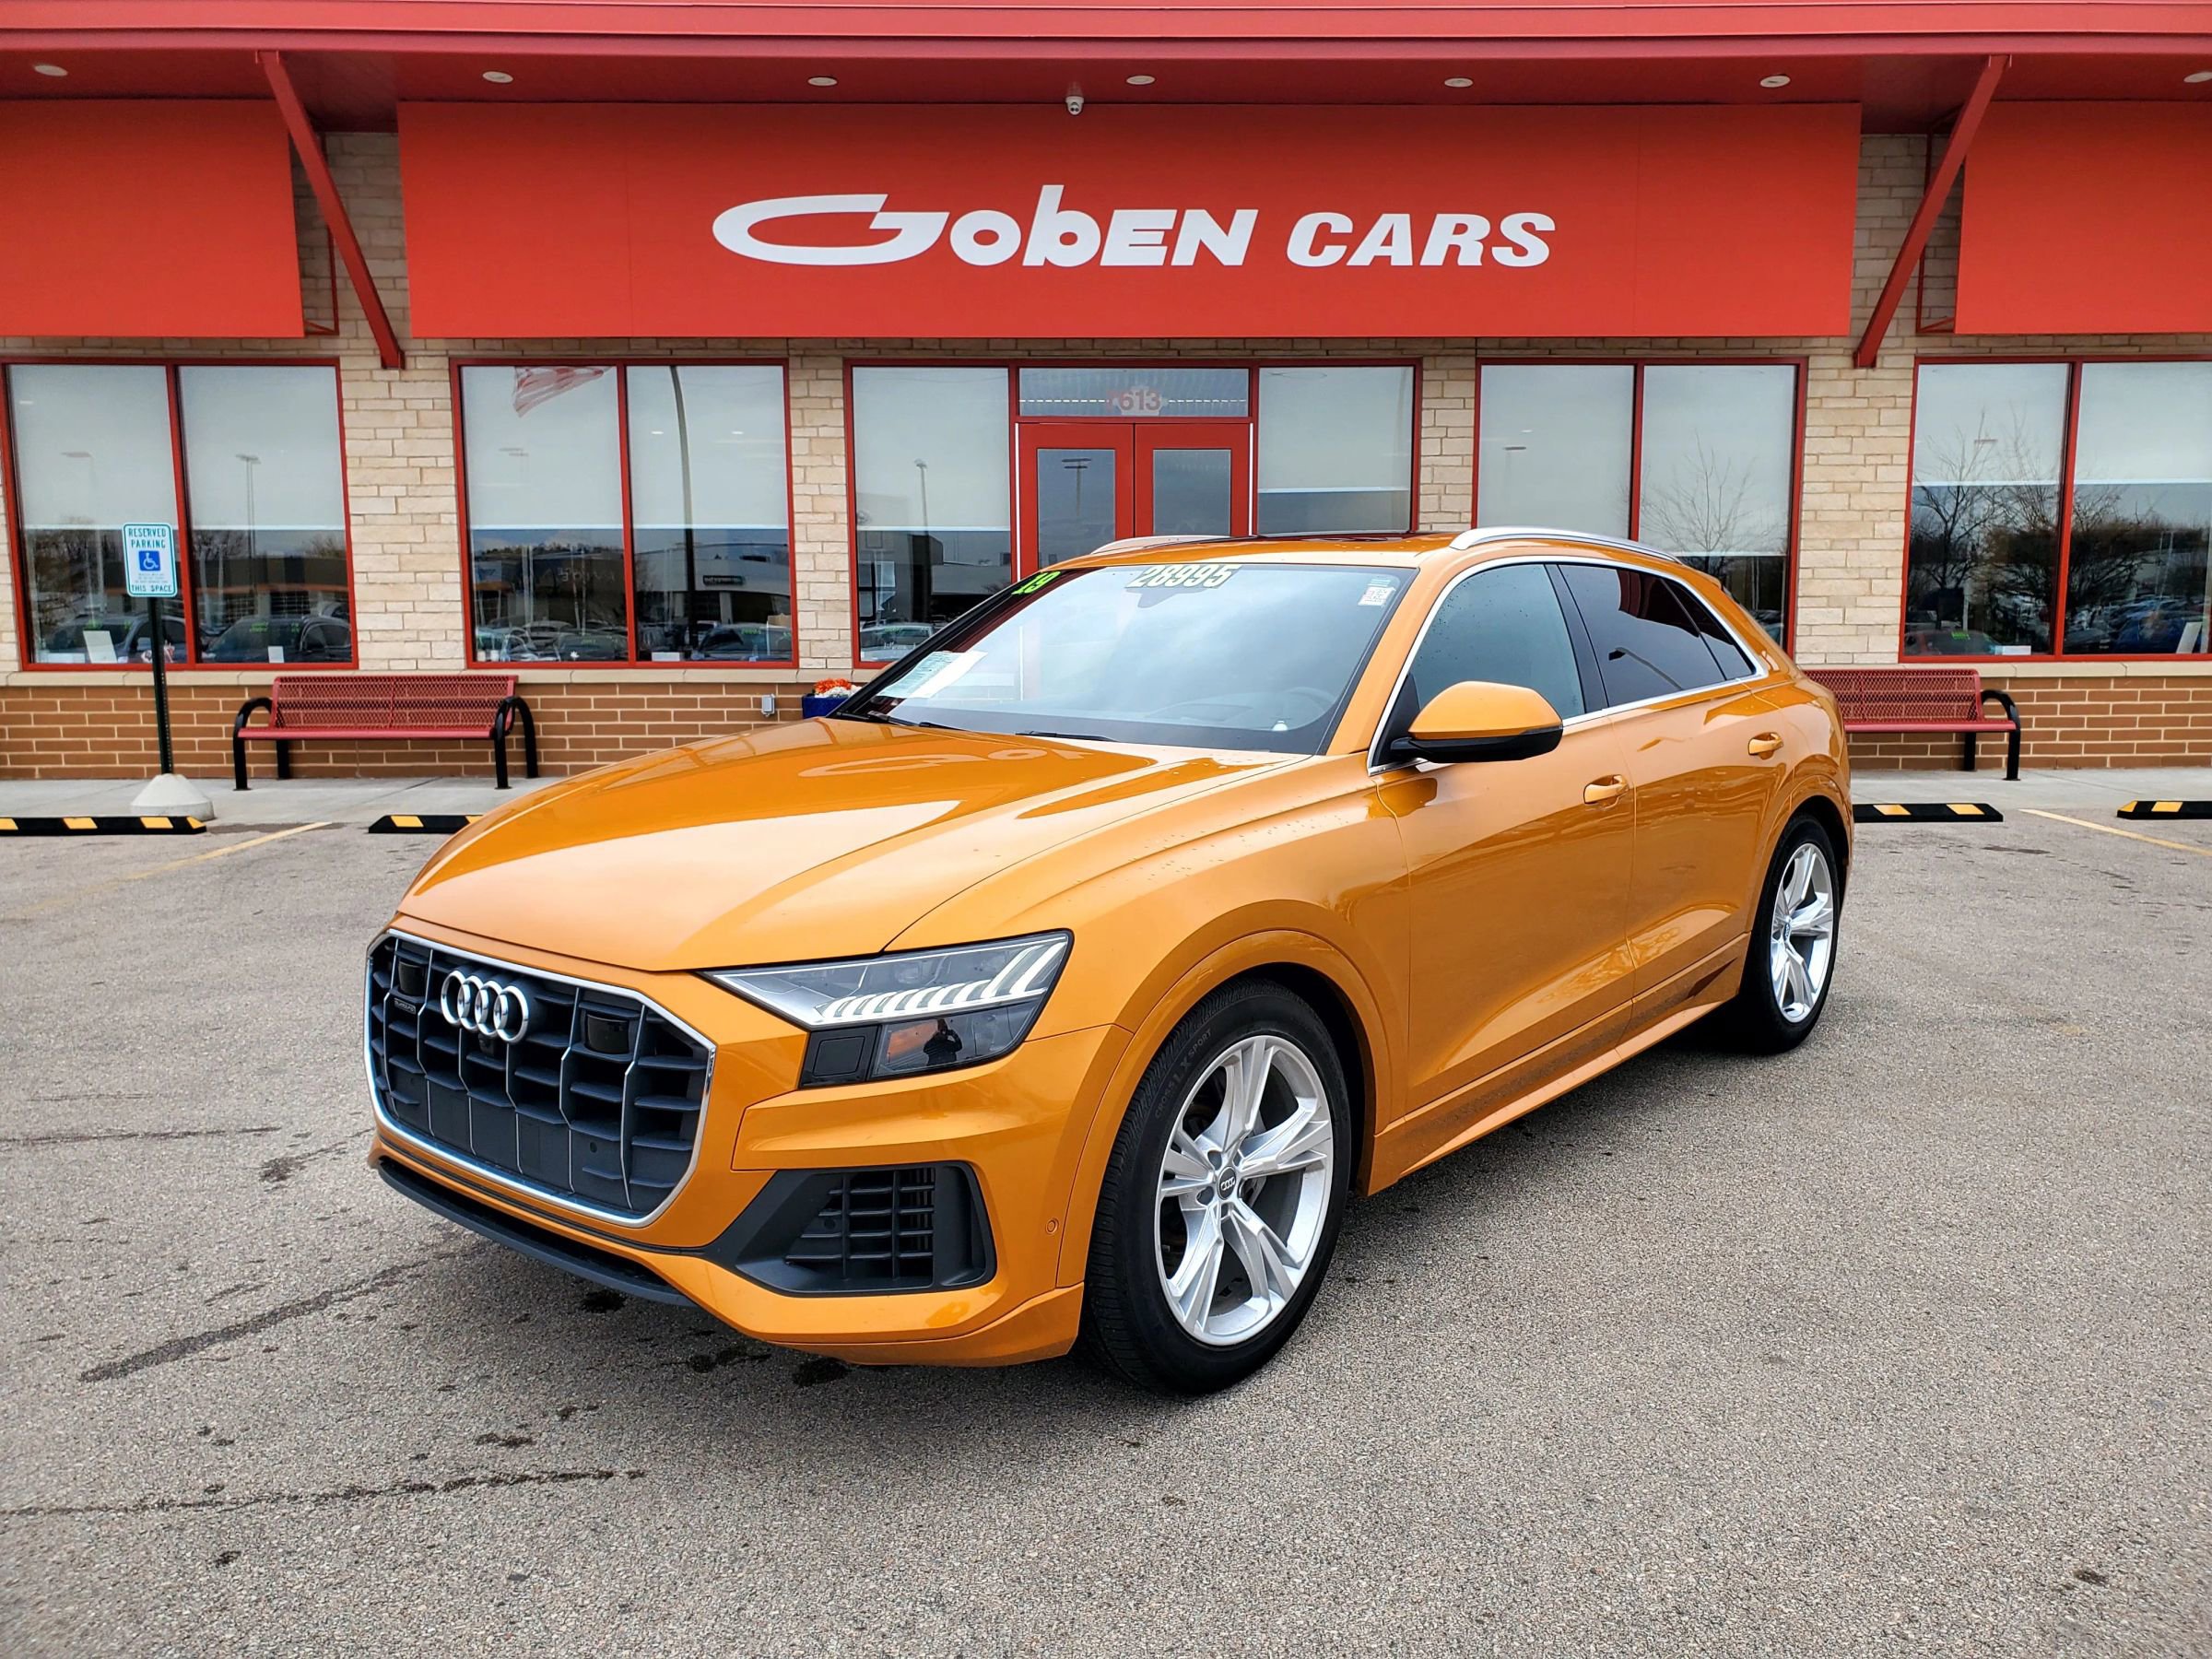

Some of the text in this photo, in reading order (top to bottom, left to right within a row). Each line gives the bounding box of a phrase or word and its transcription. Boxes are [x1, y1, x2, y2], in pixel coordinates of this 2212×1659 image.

[1287, 212, 1555, 266] CARS
[128, 527, 167, 537] RESERVED
[131, 539, 166, 548] PARKING
[1012, 571, 1062, 594] 19
[1125, 564, 1241, 588] 28995
[131, 584, 172, 593] THIS SPACE
[1188, 1028, 1212, 1056] SPORT
